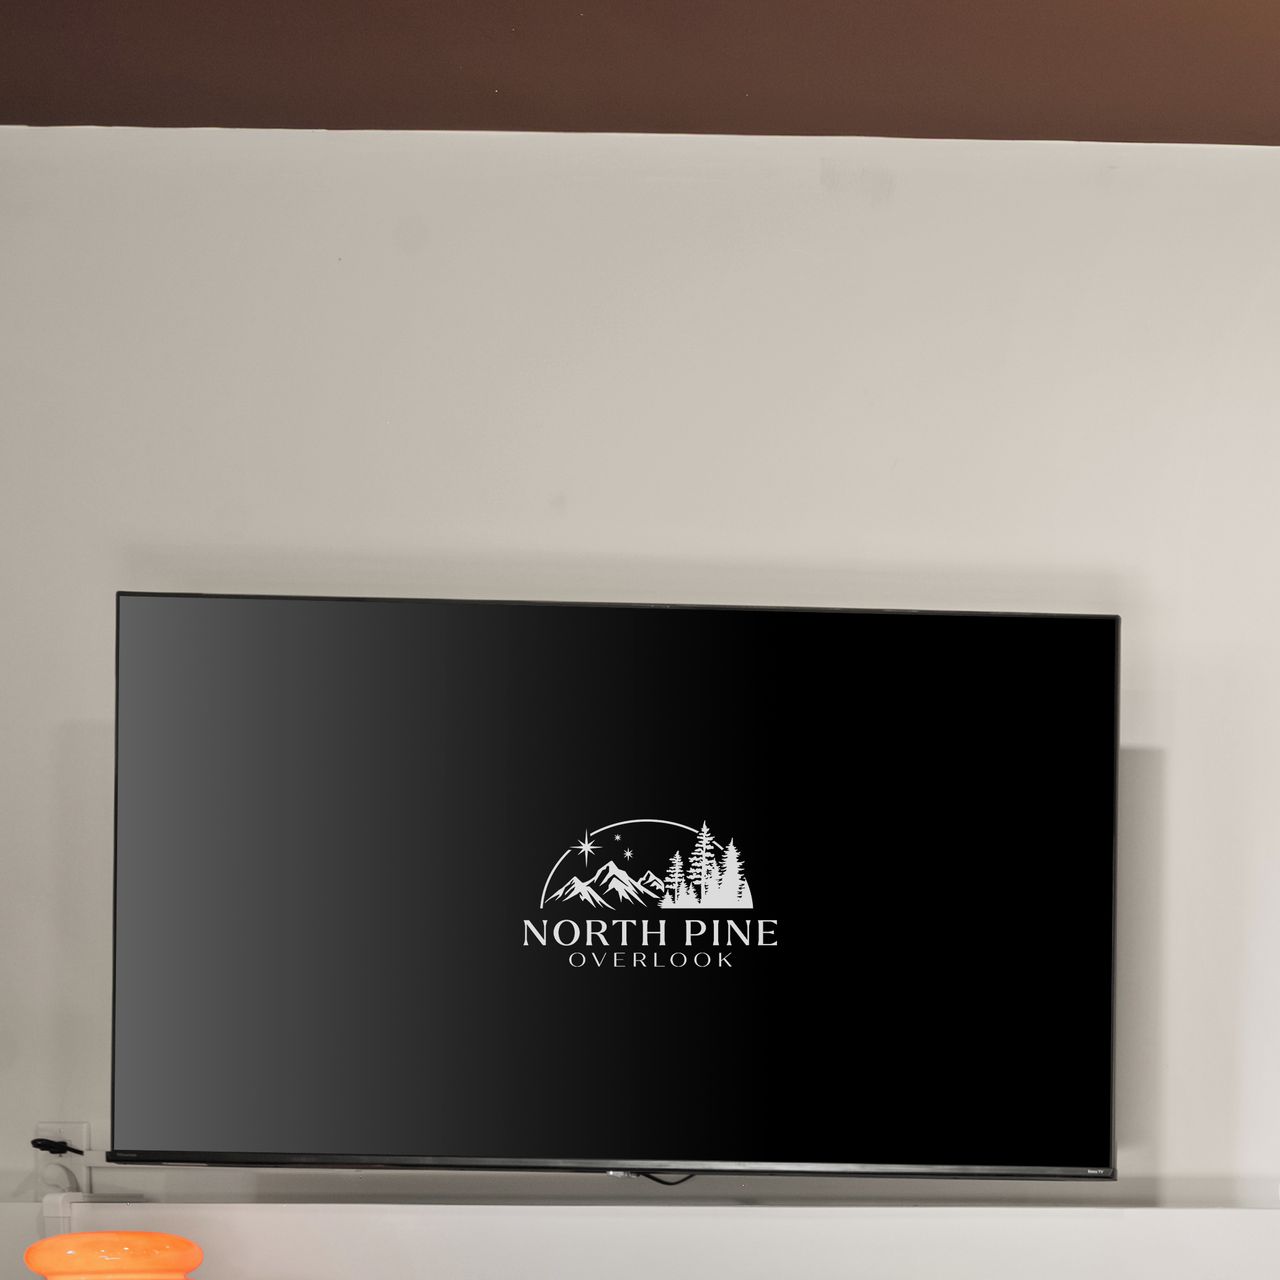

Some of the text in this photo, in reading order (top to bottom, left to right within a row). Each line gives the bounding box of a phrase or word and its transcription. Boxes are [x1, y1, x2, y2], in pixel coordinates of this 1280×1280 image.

[523, 919, 778, 946] NORTH PINE
[568, 952, 733, 968] OVERLOOK
